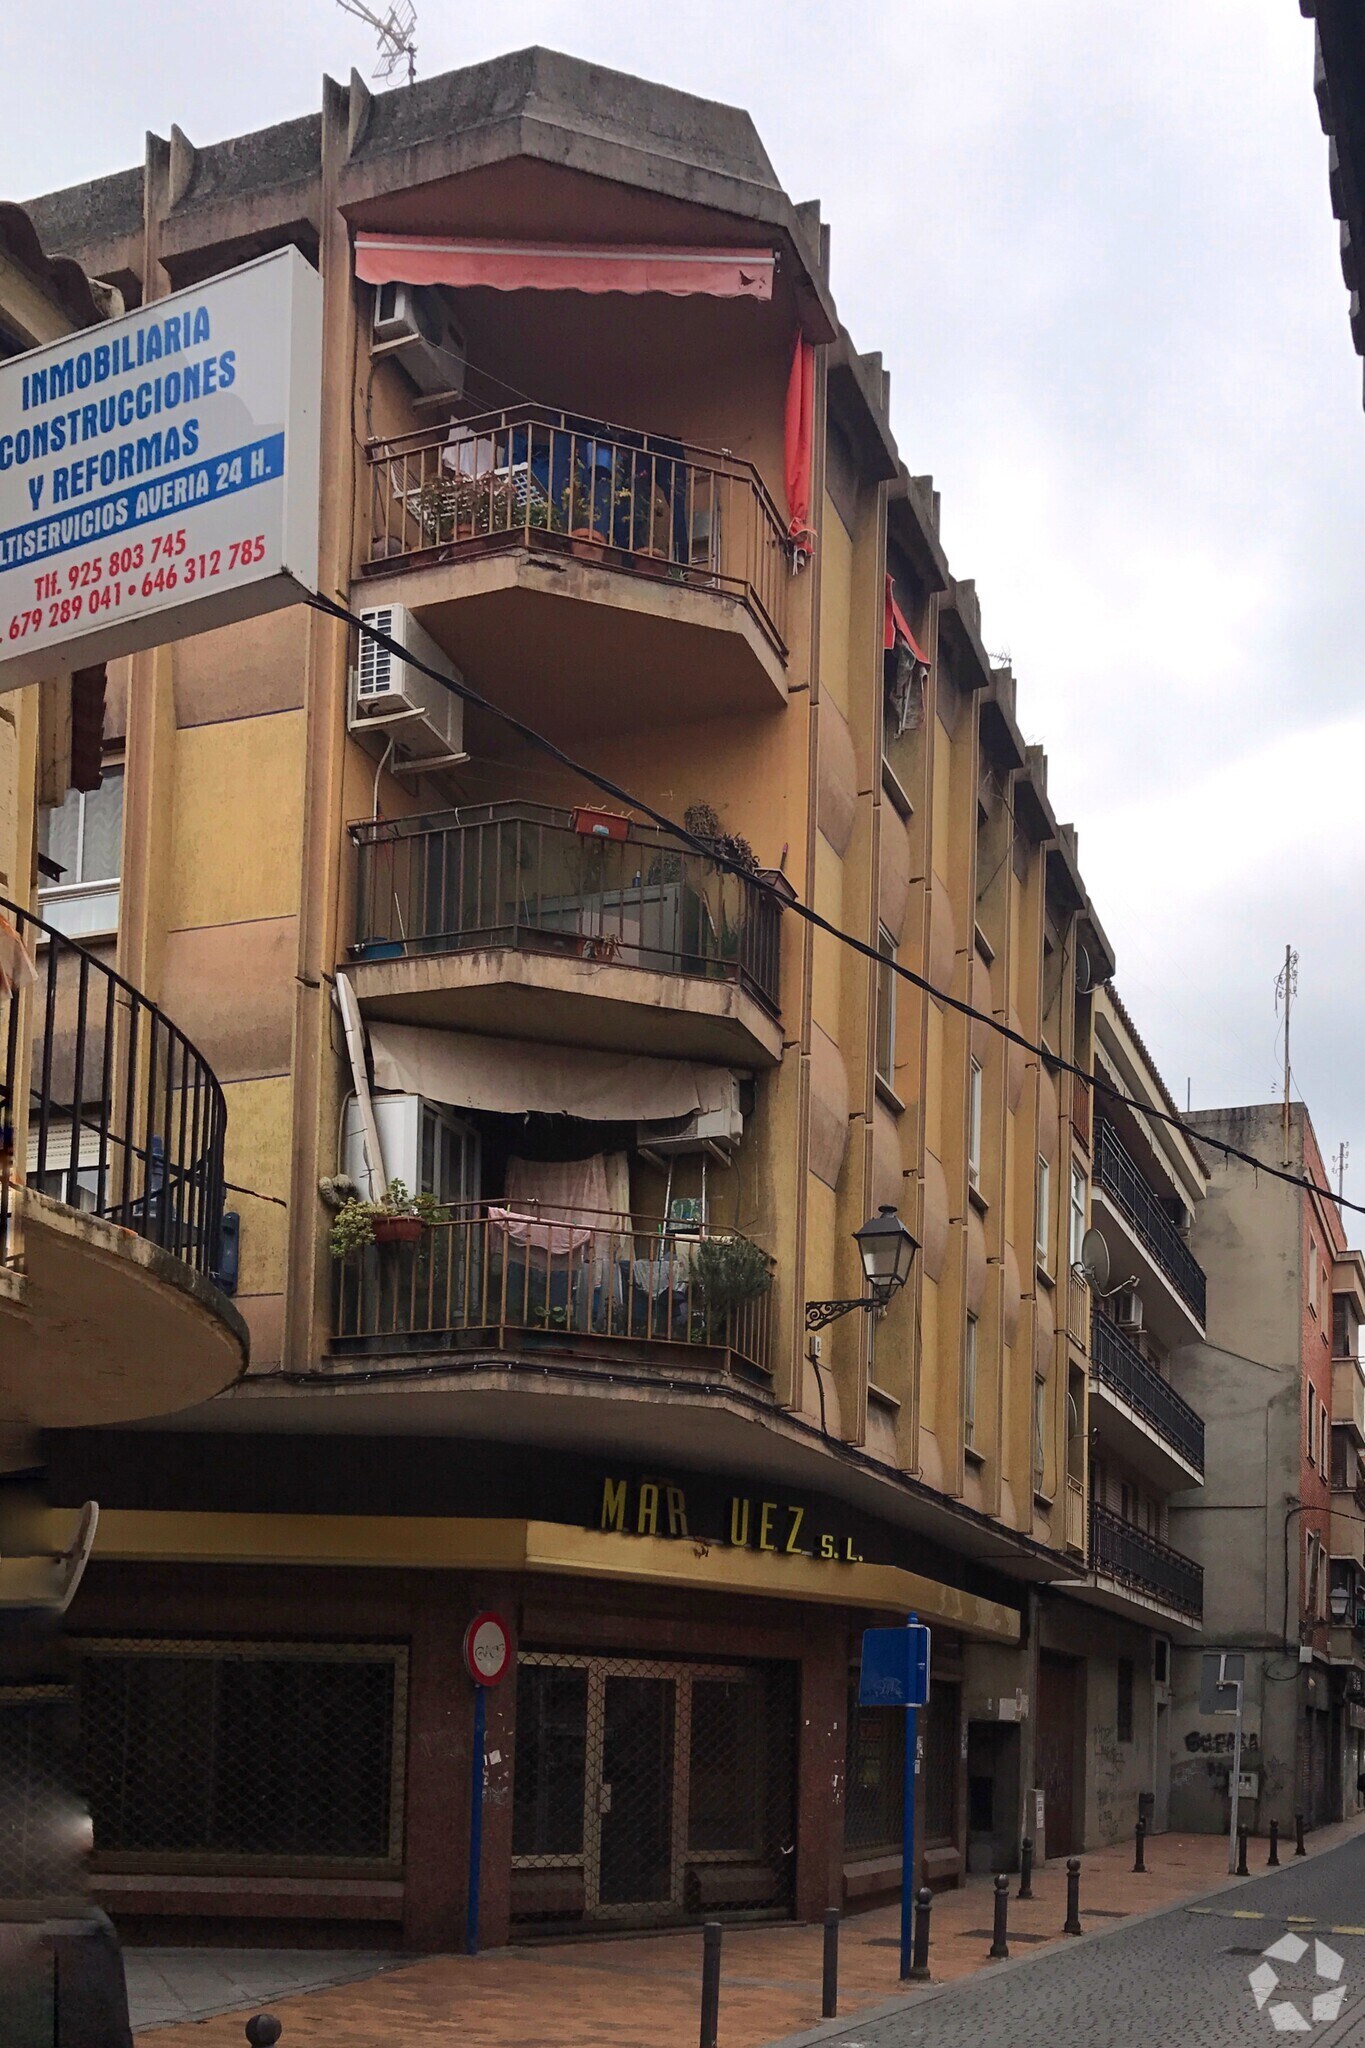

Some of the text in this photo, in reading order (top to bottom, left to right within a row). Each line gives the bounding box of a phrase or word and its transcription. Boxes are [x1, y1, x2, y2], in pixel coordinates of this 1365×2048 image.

[22, 306, 210, 411] INMOBILIARIA
[0, 350, 236, 471] CONSTRUCCIONES
[29, 418, 200, 511] Y REFORMAS
[135, 470, 209, 519] AVERIA
[215, 457, 243, 491] 24
[250, 448, 271, 479] H.
[9, 535, 265, 640] 679 289 041 646 312 785
[34, 529, 186, 601] Tlf. 925 803 745
